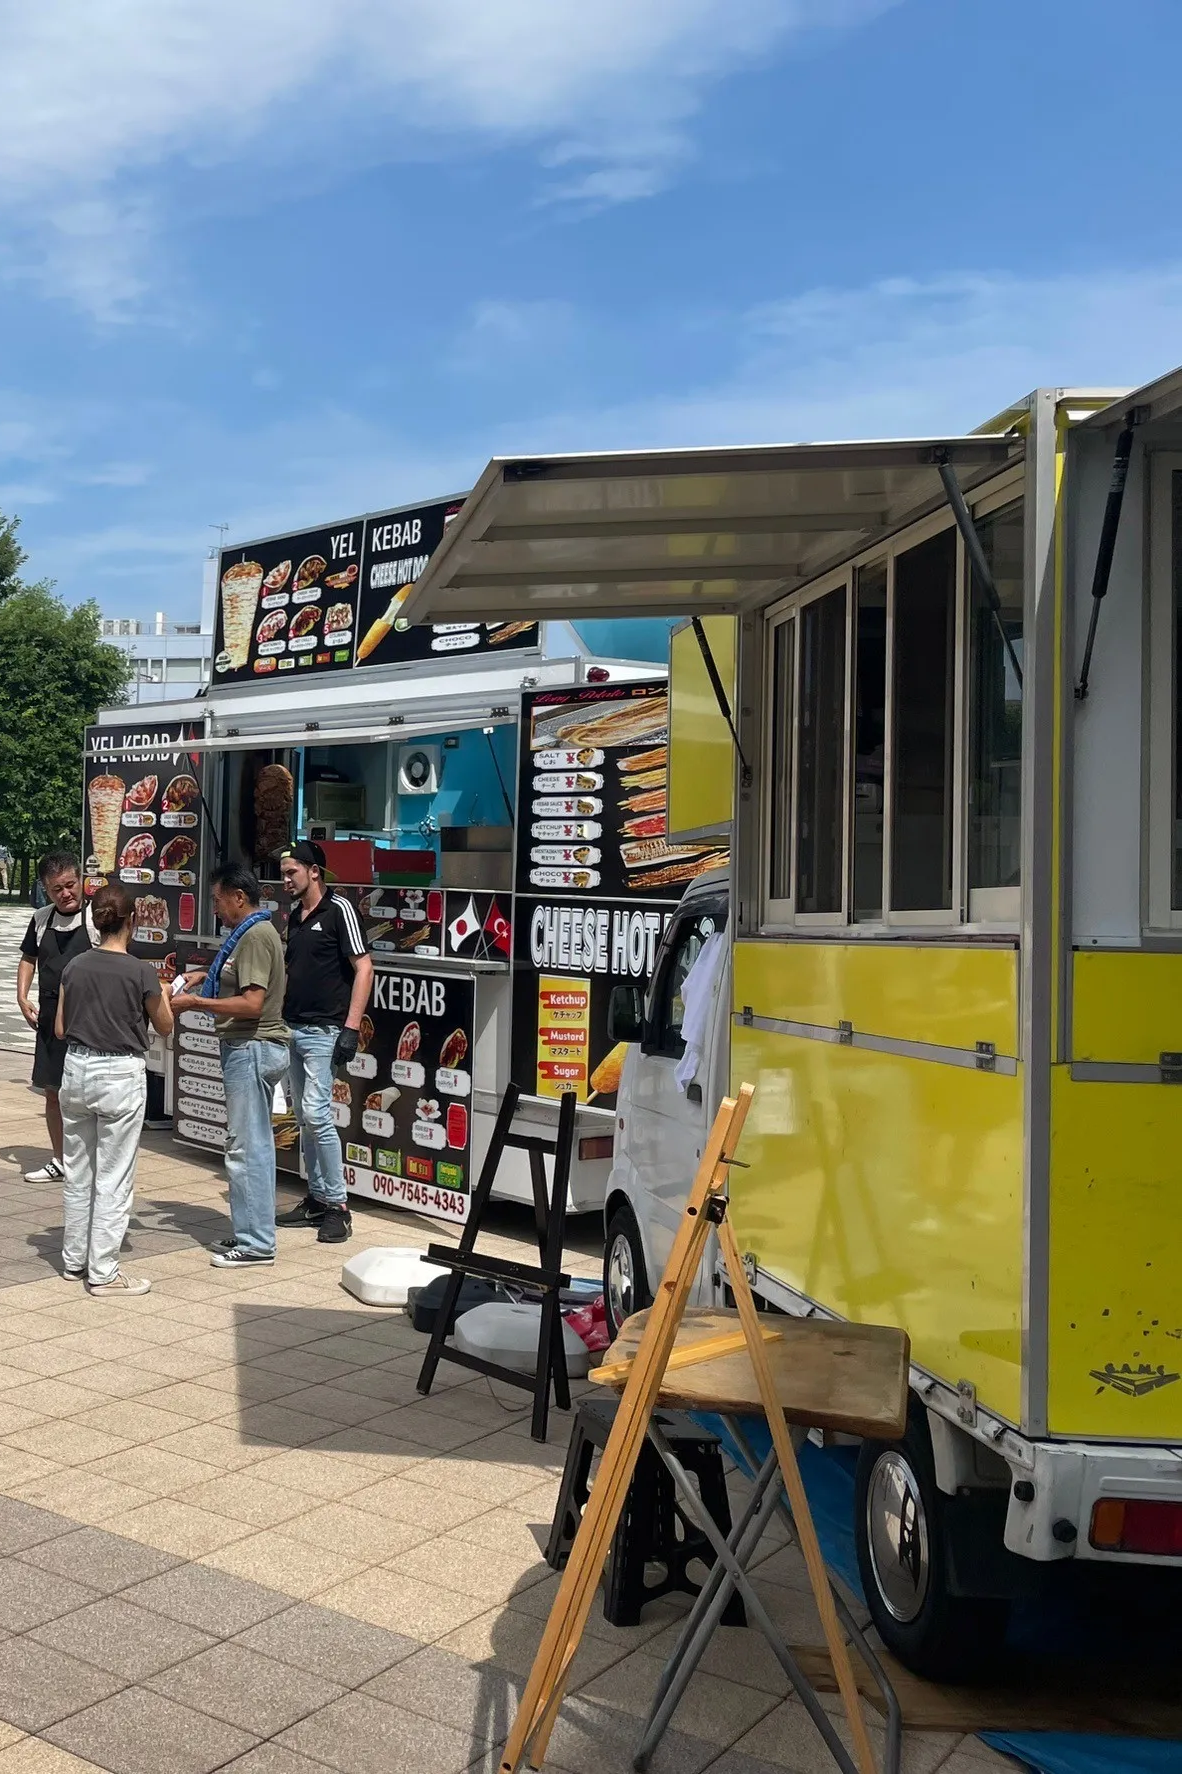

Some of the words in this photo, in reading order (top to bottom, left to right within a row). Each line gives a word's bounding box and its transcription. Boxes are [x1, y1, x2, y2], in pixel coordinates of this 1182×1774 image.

[331, 532, 356, 560] YEL
[372, 519, 422, 552] KEBAB
[370, 561, 398, 589] CHEESE
[397, 557, 413, 584] HOT
[439, 635, 472, 643] CHOCO
[91, 736, 117, 763] YEL
[122, 733, 171, 762] KEBAB
[530, 905, 609, 974] CHEESE
[611, 910, 660, 978] HOT
[374, 974, 446, 1017] KEBAB
[550, 994, 586, 1006] Ketchup
[553, 1011, 582, 1019] ケチャップ
[185, 1035, 219, 1046] CHEES
[550, 1031, 585, 1042] Mustard
[182, 1057, 206, 1067] KEBAB
[207, 1061, 222, 1070] SAU
[553, 1064, 580, 1079] Sugar
[181, 1079, 223, 1092] KETCHU
[186, 1122, 223, 1136] CHOCO
[192, 1130, 216, 1140] チョコ
[373, 1174, 465, 1215] 090-7545-4343
